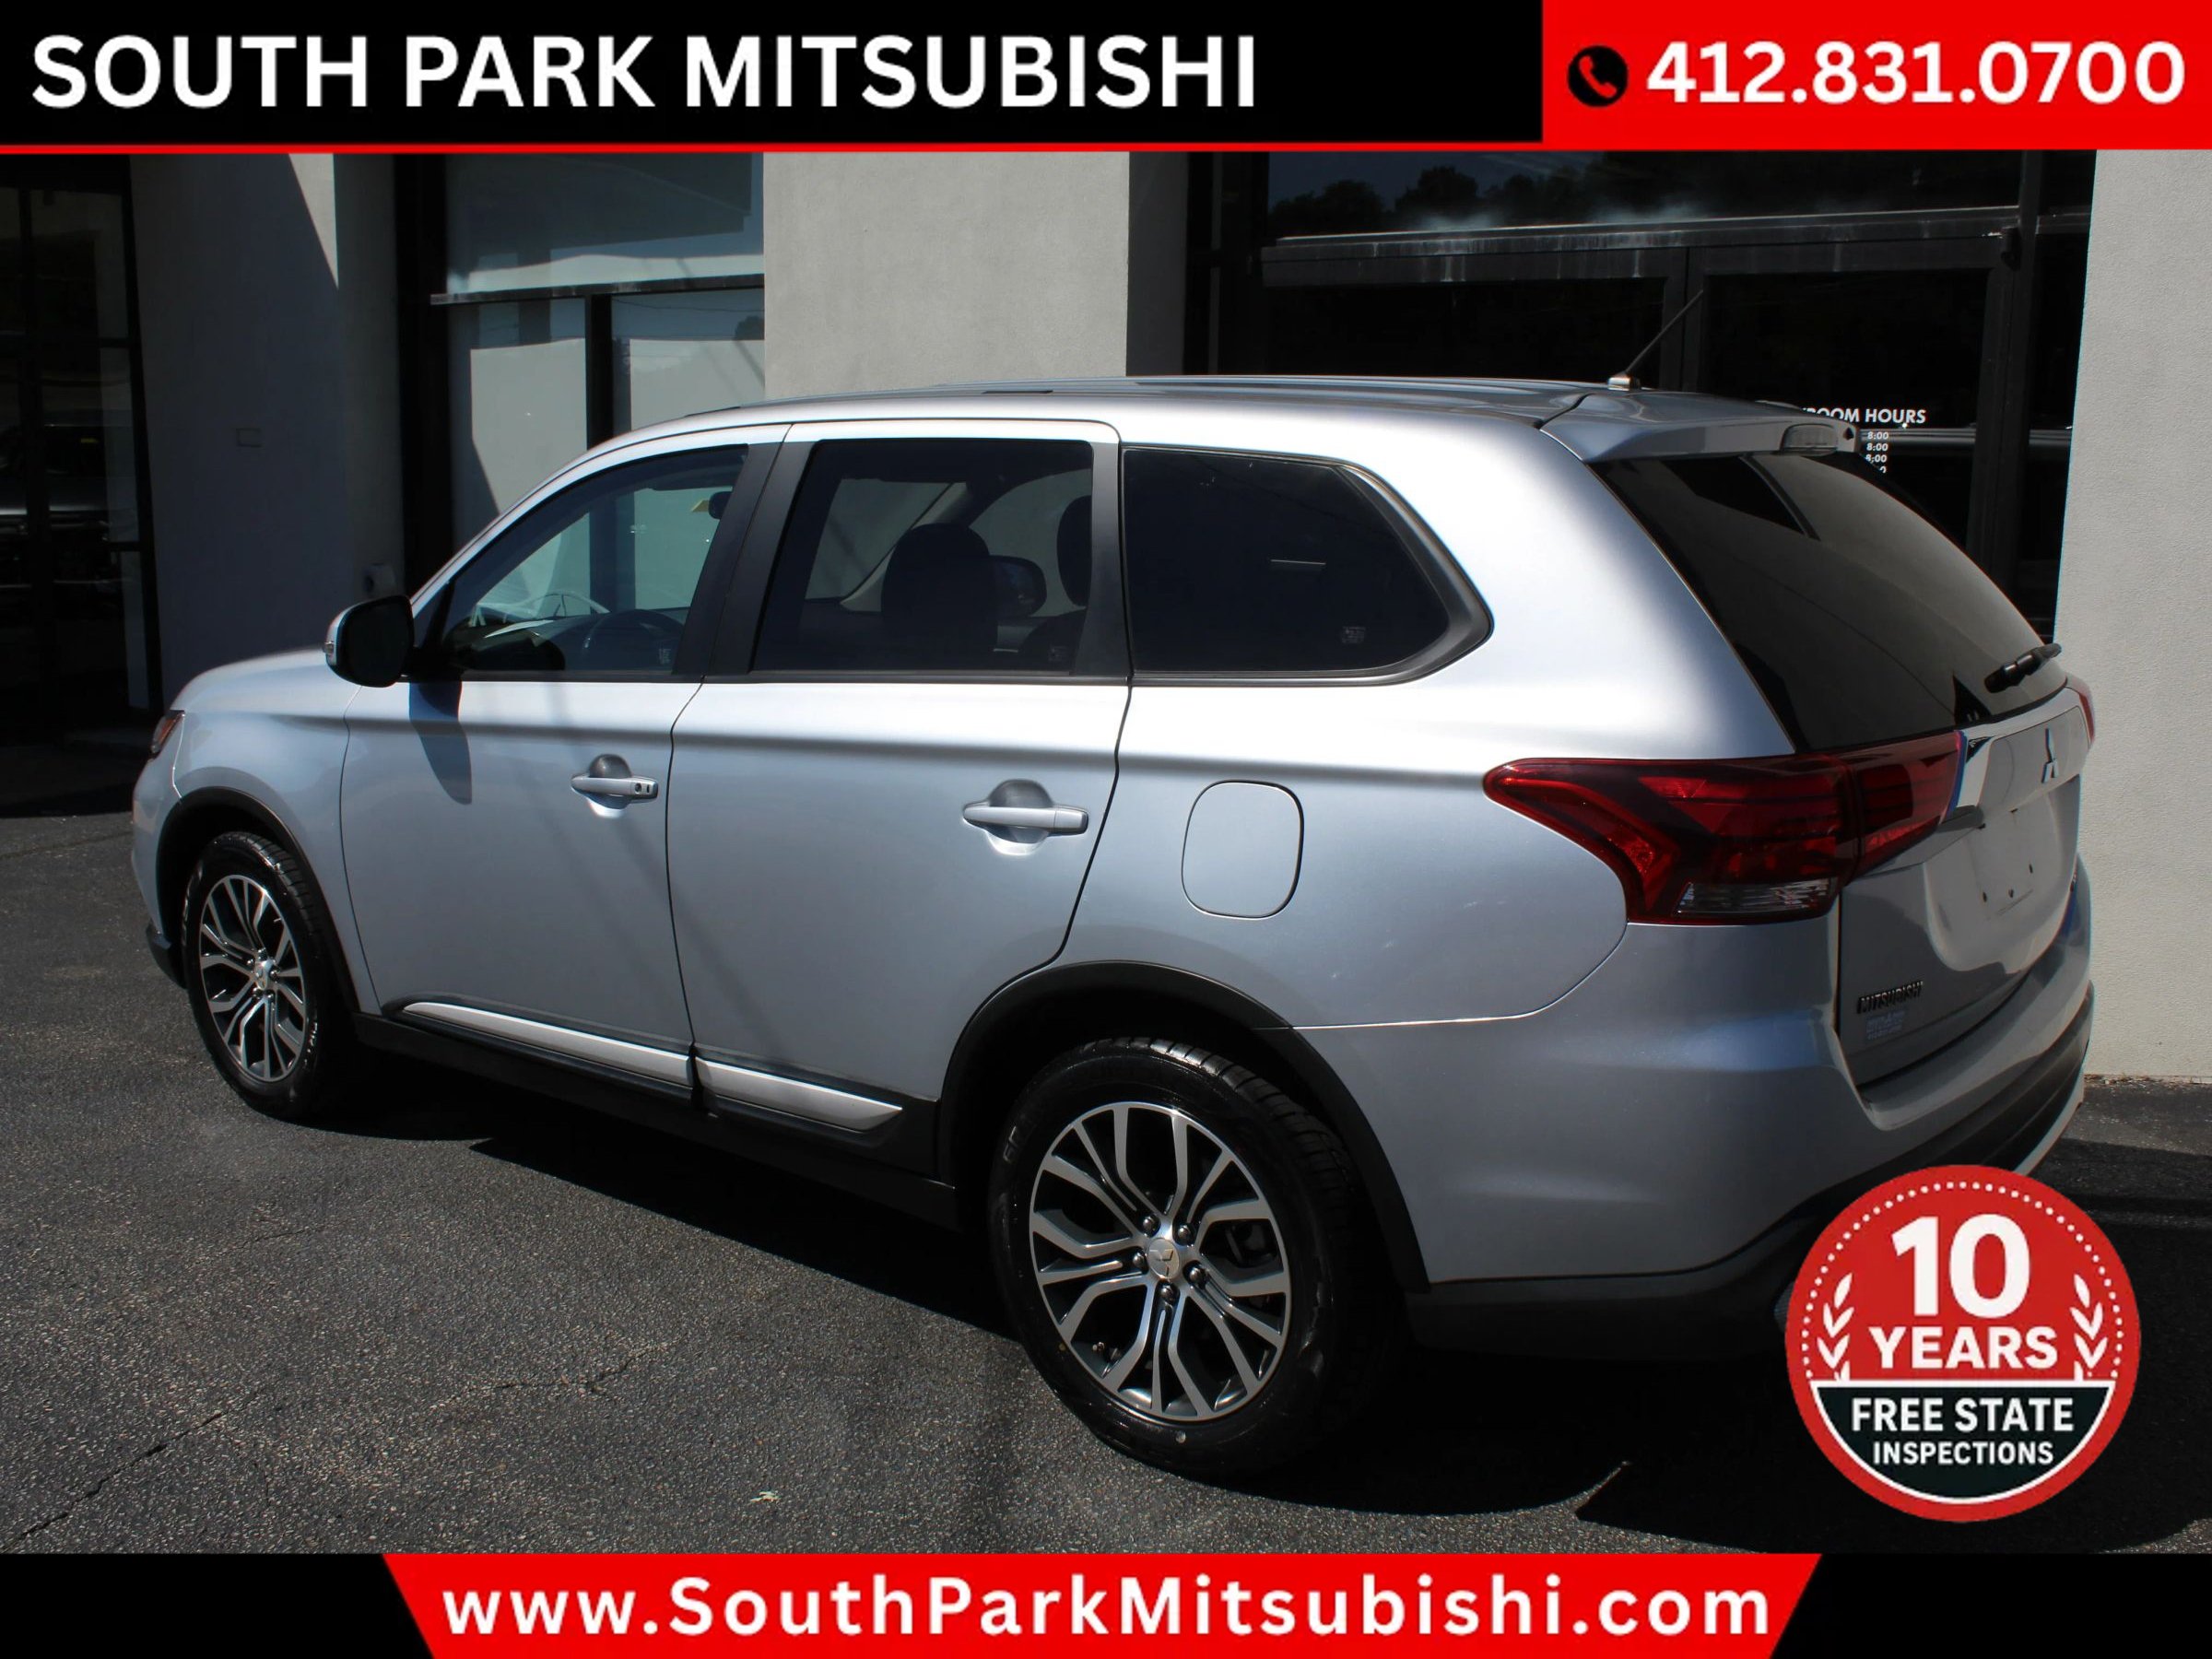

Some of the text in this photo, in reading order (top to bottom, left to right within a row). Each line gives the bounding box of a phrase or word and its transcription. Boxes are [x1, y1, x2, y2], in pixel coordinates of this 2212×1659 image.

[1865, 408, 1926, 423] HOURS
[1867, 431, 1889, 440] 8:00
[1866, 442, 1888, 452] 8:00
